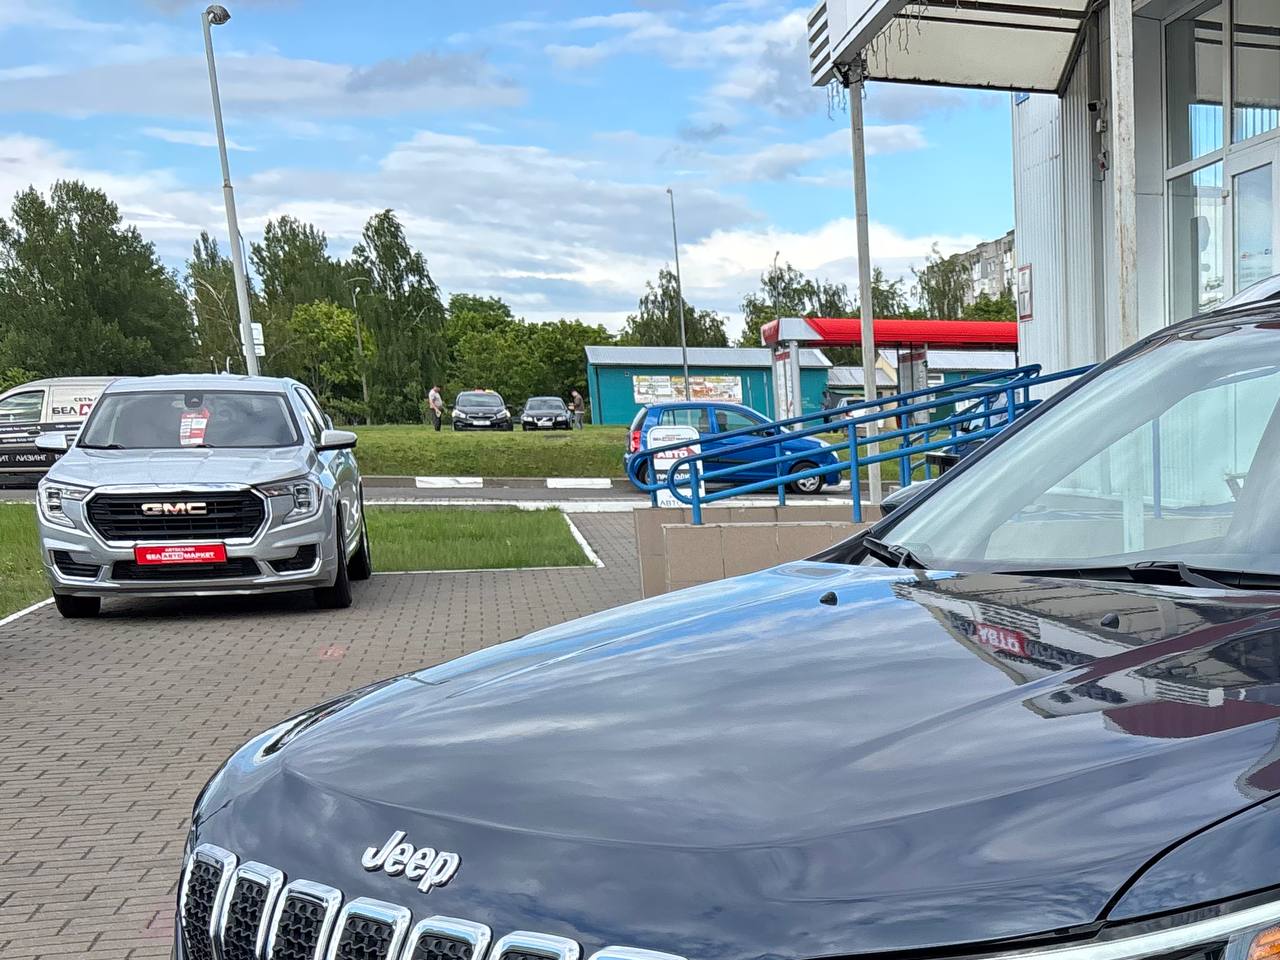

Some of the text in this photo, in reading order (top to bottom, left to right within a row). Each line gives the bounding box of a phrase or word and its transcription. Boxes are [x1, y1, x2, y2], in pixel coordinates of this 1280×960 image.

[15, 454, 47, 462] ЛИЗИНГ
[141, 502, 207, 515] GMC
[361, 830, 461, 894] Jeep
